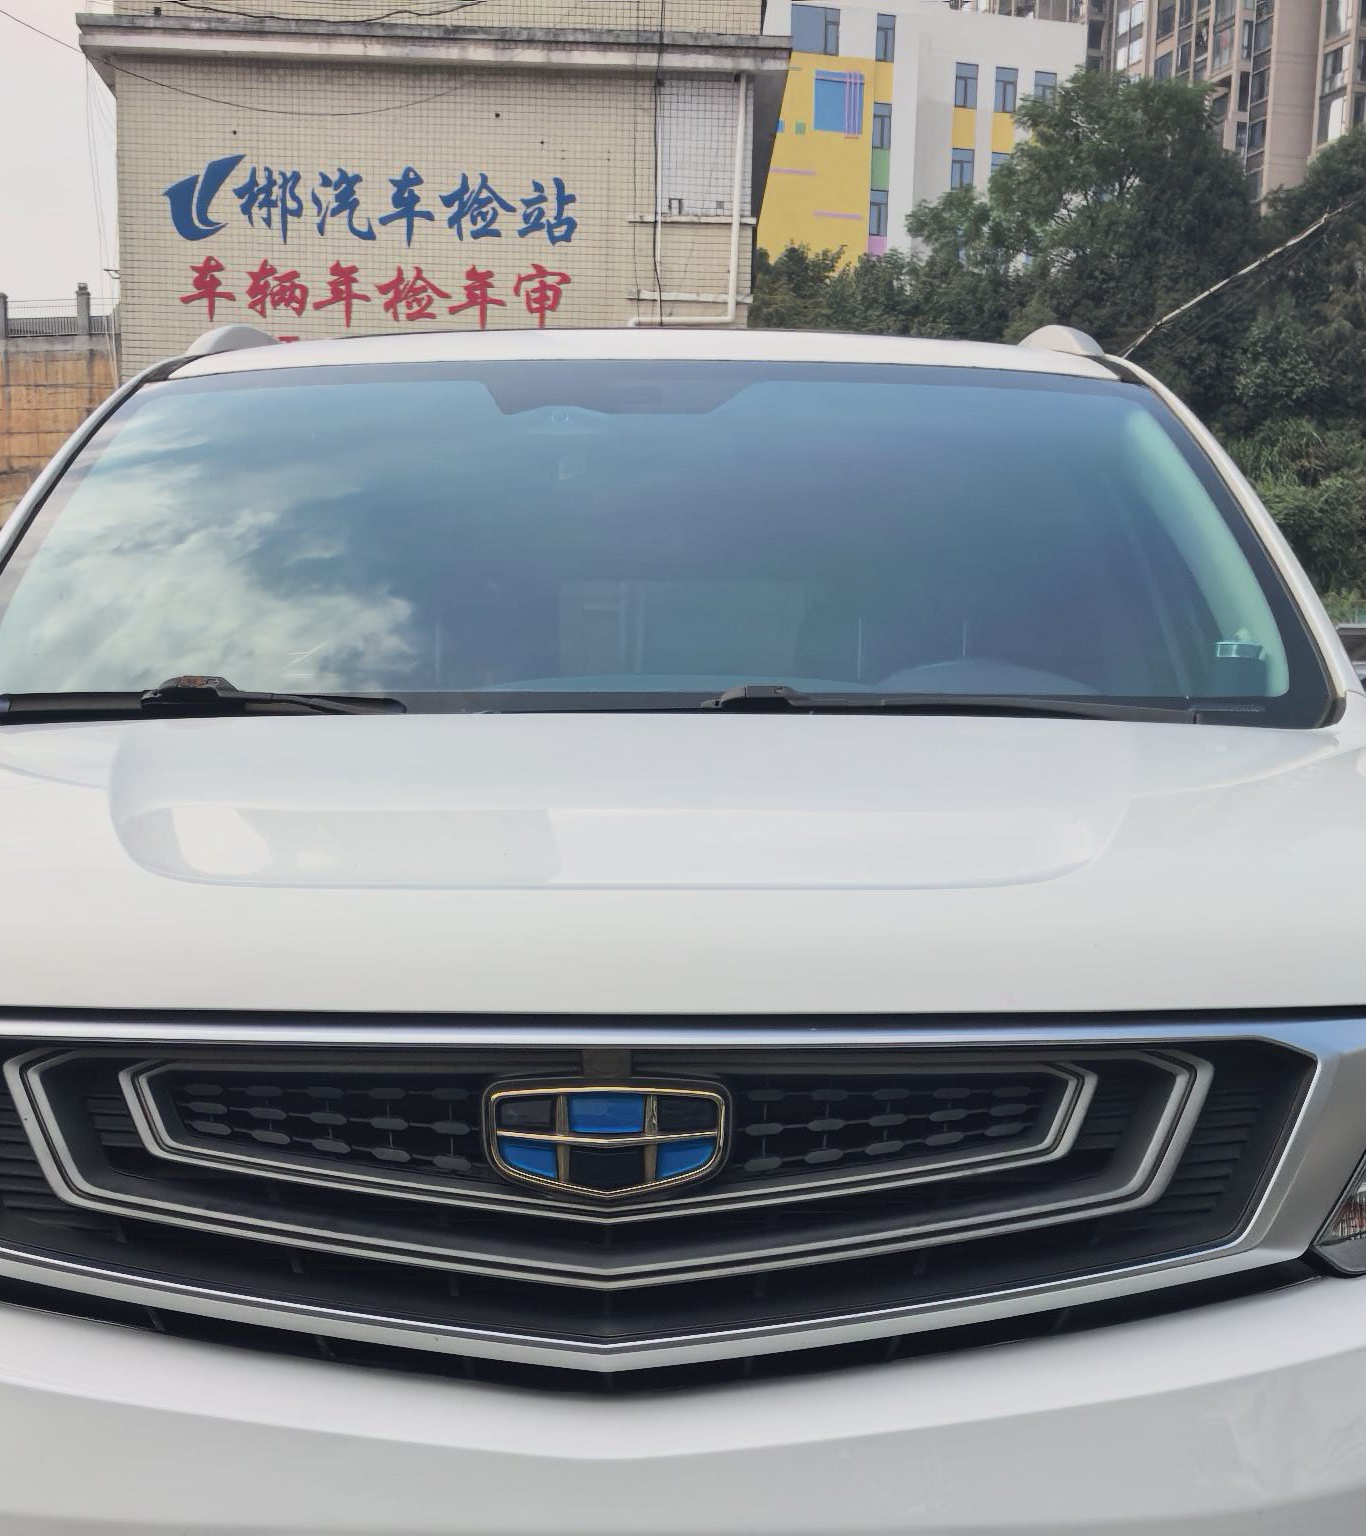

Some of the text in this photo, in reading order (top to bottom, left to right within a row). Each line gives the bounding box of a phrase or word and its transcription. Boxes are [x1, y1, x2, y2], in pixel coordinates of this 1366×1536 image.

[233, 165, 578, 248] 郴汽车检站
[180, 255, 572, 330] 车辆年检年审
